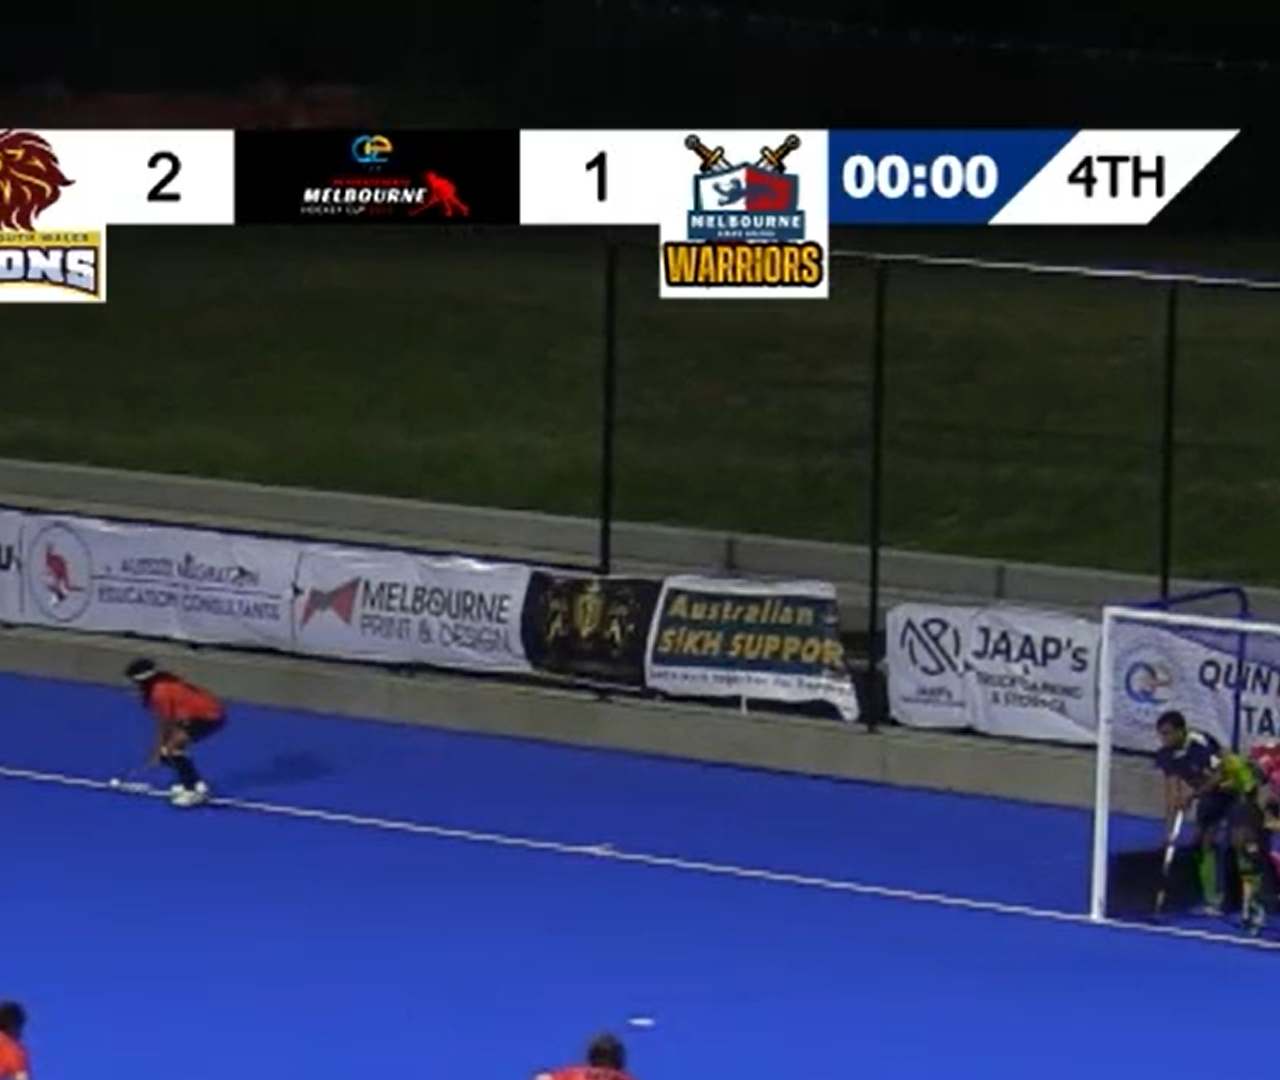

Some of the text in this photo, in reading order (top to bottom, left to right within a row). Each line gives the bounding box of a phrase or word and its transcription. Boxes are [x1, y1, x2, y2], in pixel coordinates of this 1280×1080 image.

[361, 579, 511, 624] MELBOURNE
[669, 594, 816, 627] Australian
[658, 627, 723, 657] SIKH
[972, 626, 1089, 673] JAAP's
